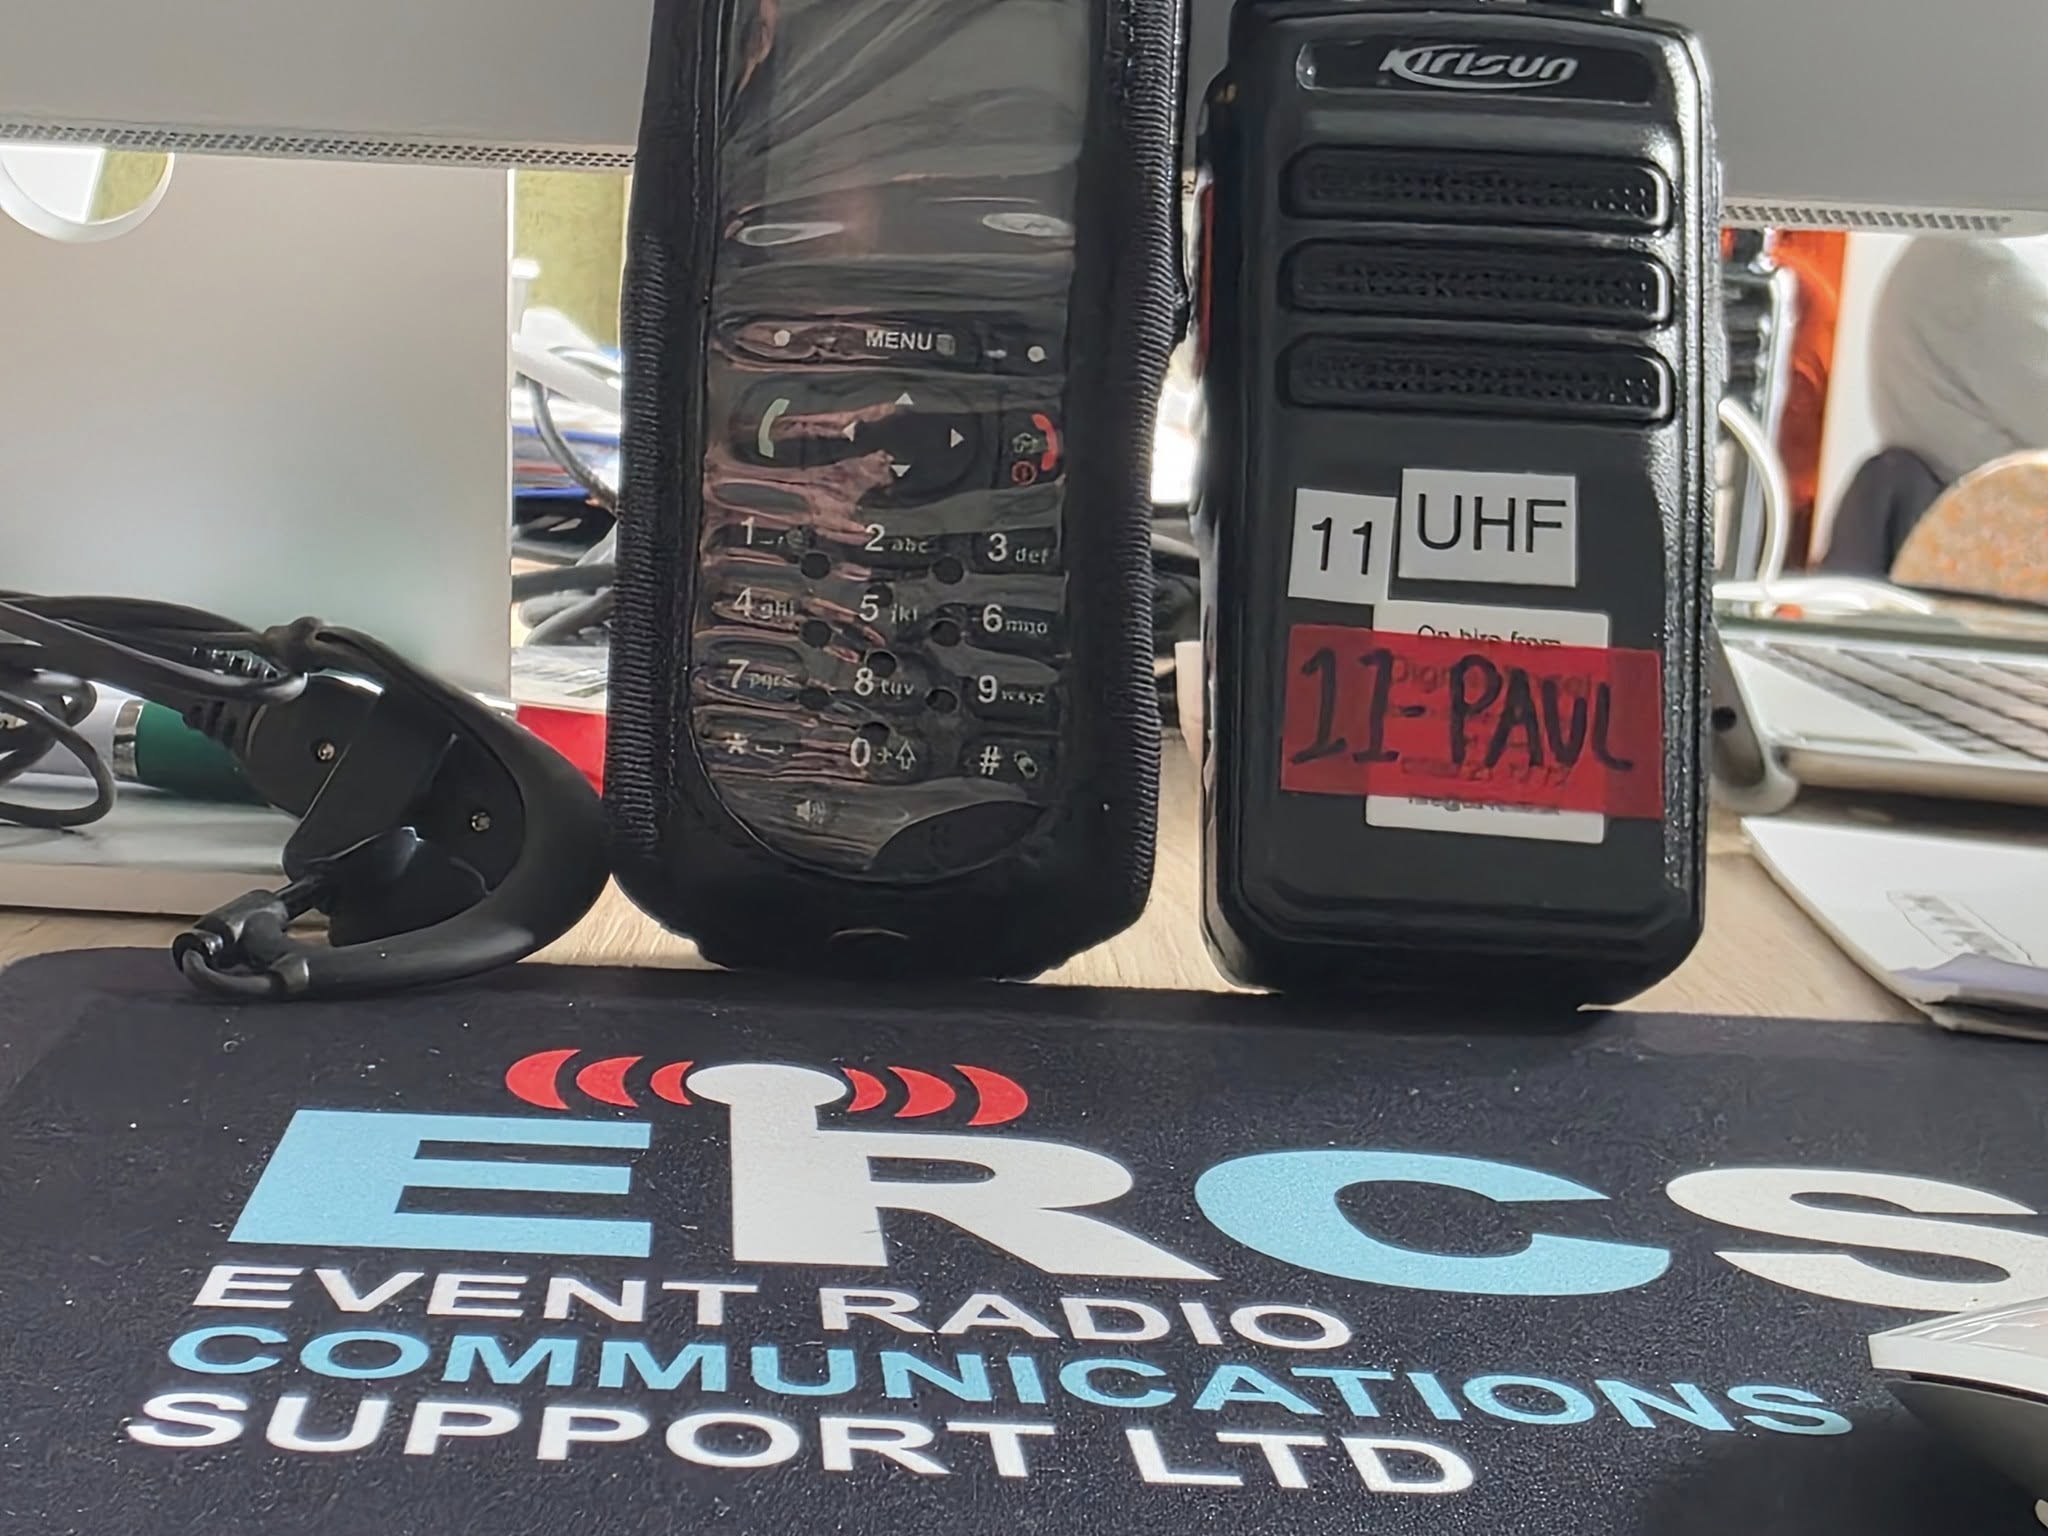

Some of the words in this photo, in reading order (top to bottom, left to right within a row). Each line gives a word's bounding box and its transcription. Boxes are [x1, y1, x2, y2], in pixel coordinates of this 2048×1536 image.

[865, 330, 932, 351] MENU
[741, 516, 755, 545] 1
[865, 524, 885, 552] 2
[1417, 493, 1568, 554] UHF
[987, 533, 1008, 562] 3
[1312, 516, 1373, 576] 11
[734, 587, 752, 618] 4
[859, 594, 880, 622] 5
[983, 604, 1003, 633] 6
[728, 659, 749, 688] 7
[853, 667, 875, 696] 8
[977, 674, 998, 703] 9
[850, 737, 871, 768] 0
[226, 1062, 2048, 1310] ERCS
[193, 1265, 760, 1326] EVENT
[819, 1287, 1354, 1350] RADIO
[168, 1325, 1854, 1436] COMMUNICATIONS
[126, 1392, 1056, 1478] SUPPORT
[1124, 1427, 1476, 1494] LTD
